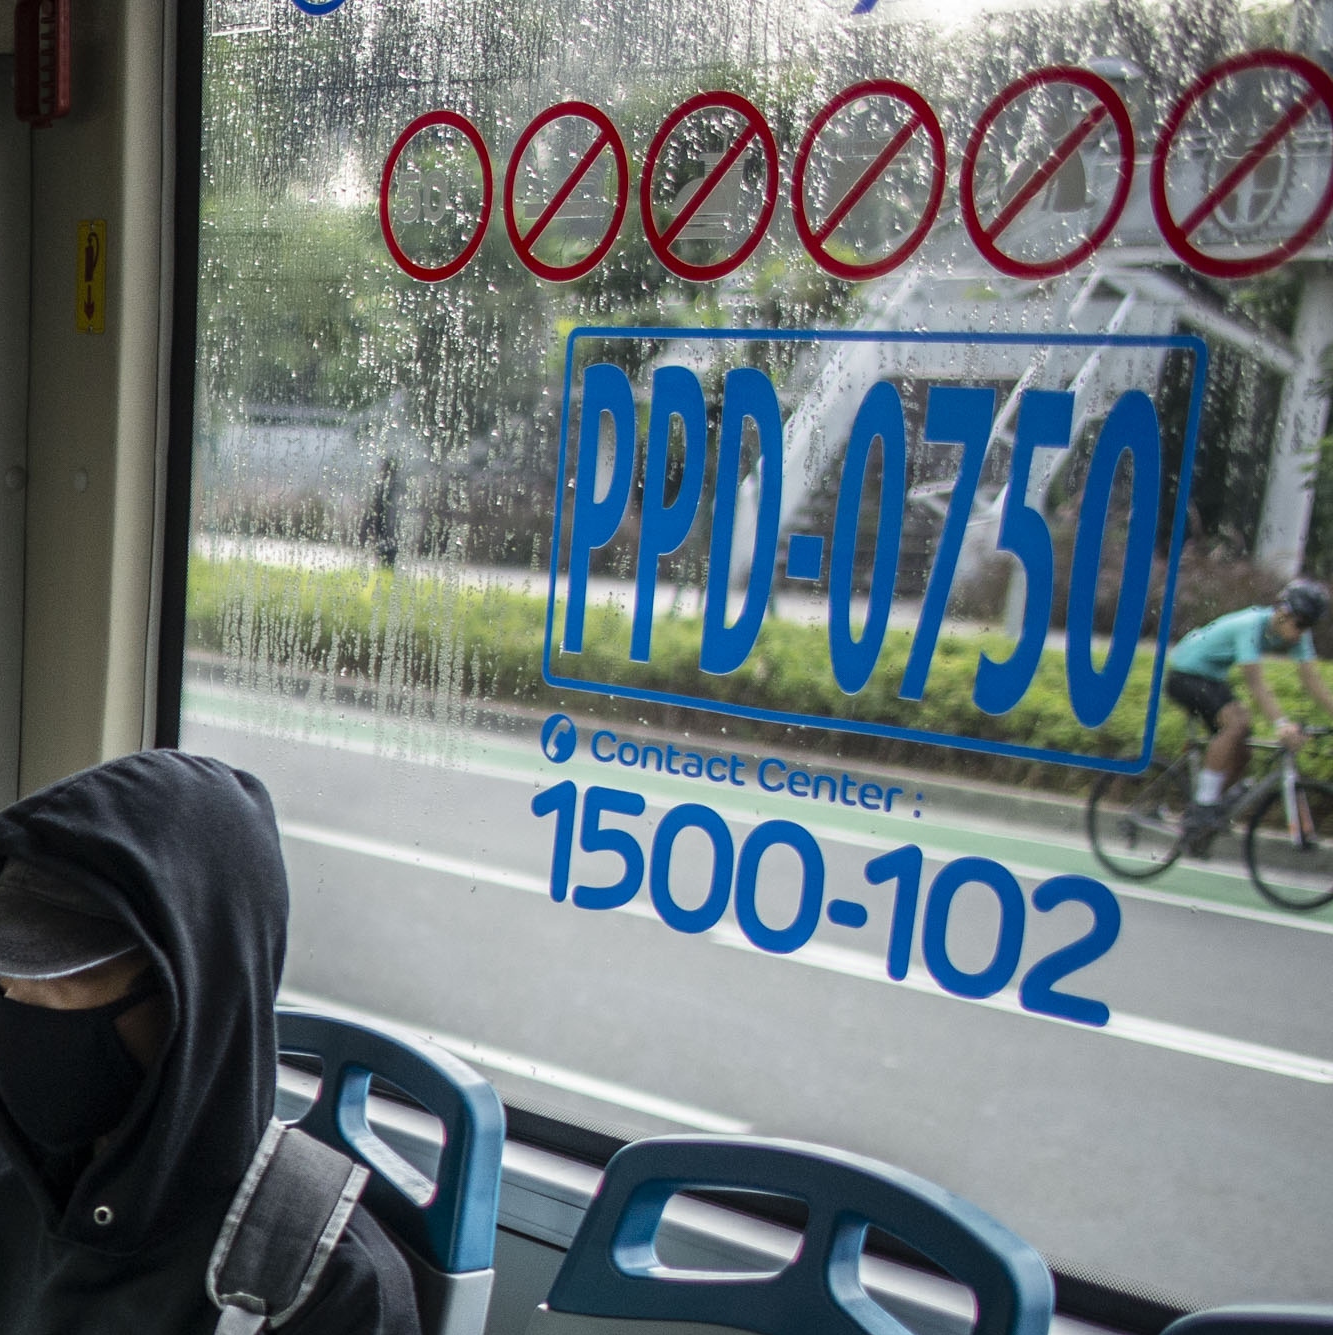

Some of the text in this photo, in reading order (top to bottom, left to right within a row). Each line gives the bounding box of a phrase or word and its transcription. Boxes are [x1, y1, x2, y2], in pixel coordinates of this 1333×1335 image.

[561, 362, 1161, 728] PPD-0750
[590, 729, 746, 787] Contact
[756, 756, 904, 812] Center
[531, 779, 1122, 1028] 1500-102
